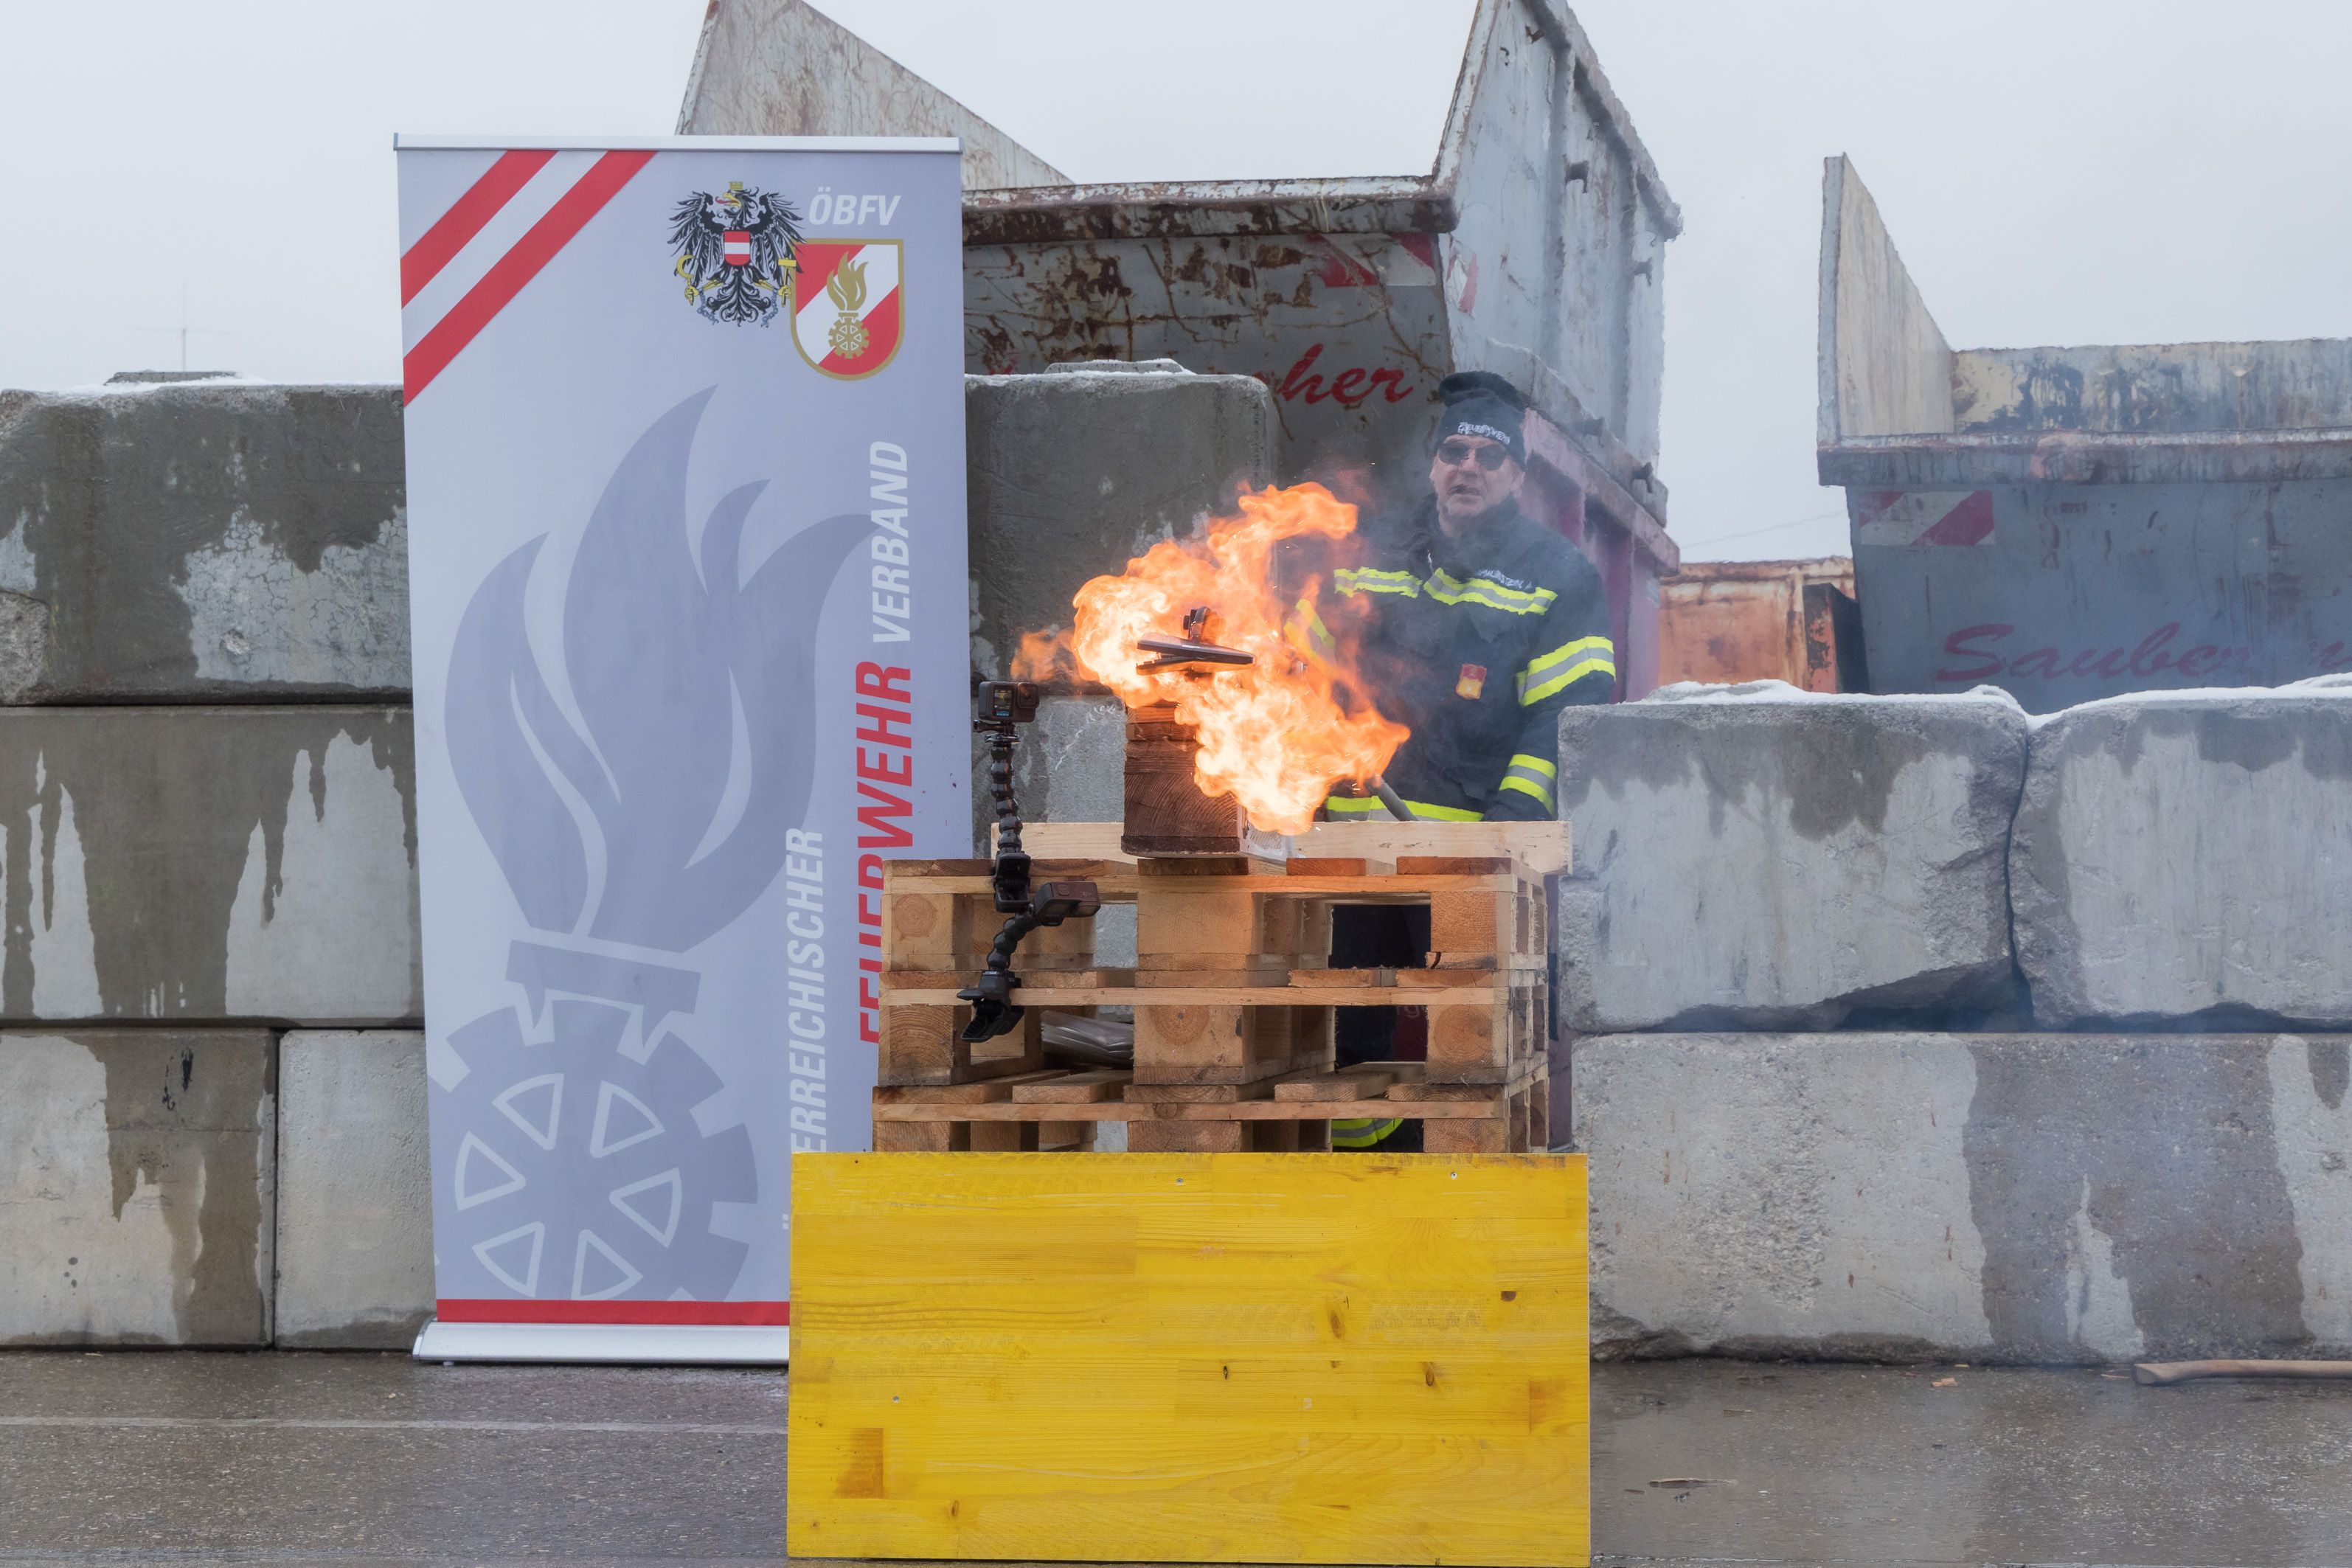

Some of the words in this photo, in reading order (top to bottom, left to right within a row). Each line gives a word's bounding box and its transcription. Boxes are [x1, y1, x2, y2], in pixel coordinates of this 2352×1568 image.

[809, 187, 901, 226] ÖBFV
[1253, 342, 1414, 404] her
[869, 442, 911, 643] VERBAND
[783, 828, 827, 1230] ERREICHISCHER
